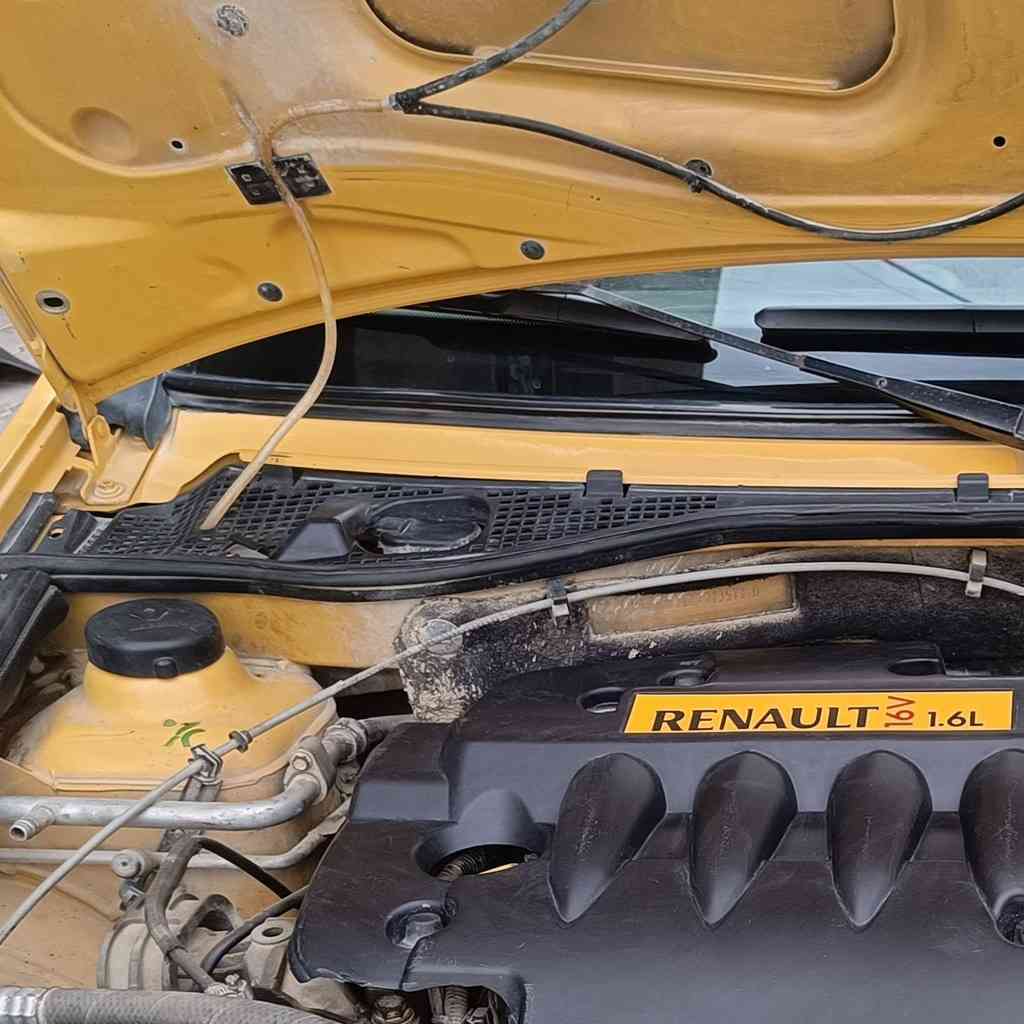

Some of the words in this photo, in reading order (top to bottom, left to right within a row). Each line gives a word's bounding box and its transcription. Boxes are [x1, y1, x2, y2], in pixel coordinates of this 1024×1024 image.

[650, 706, 879, 732] RENAULT
[883, 696, 916, 728] 16V
[927, 710, 984, 728] 1.6L
